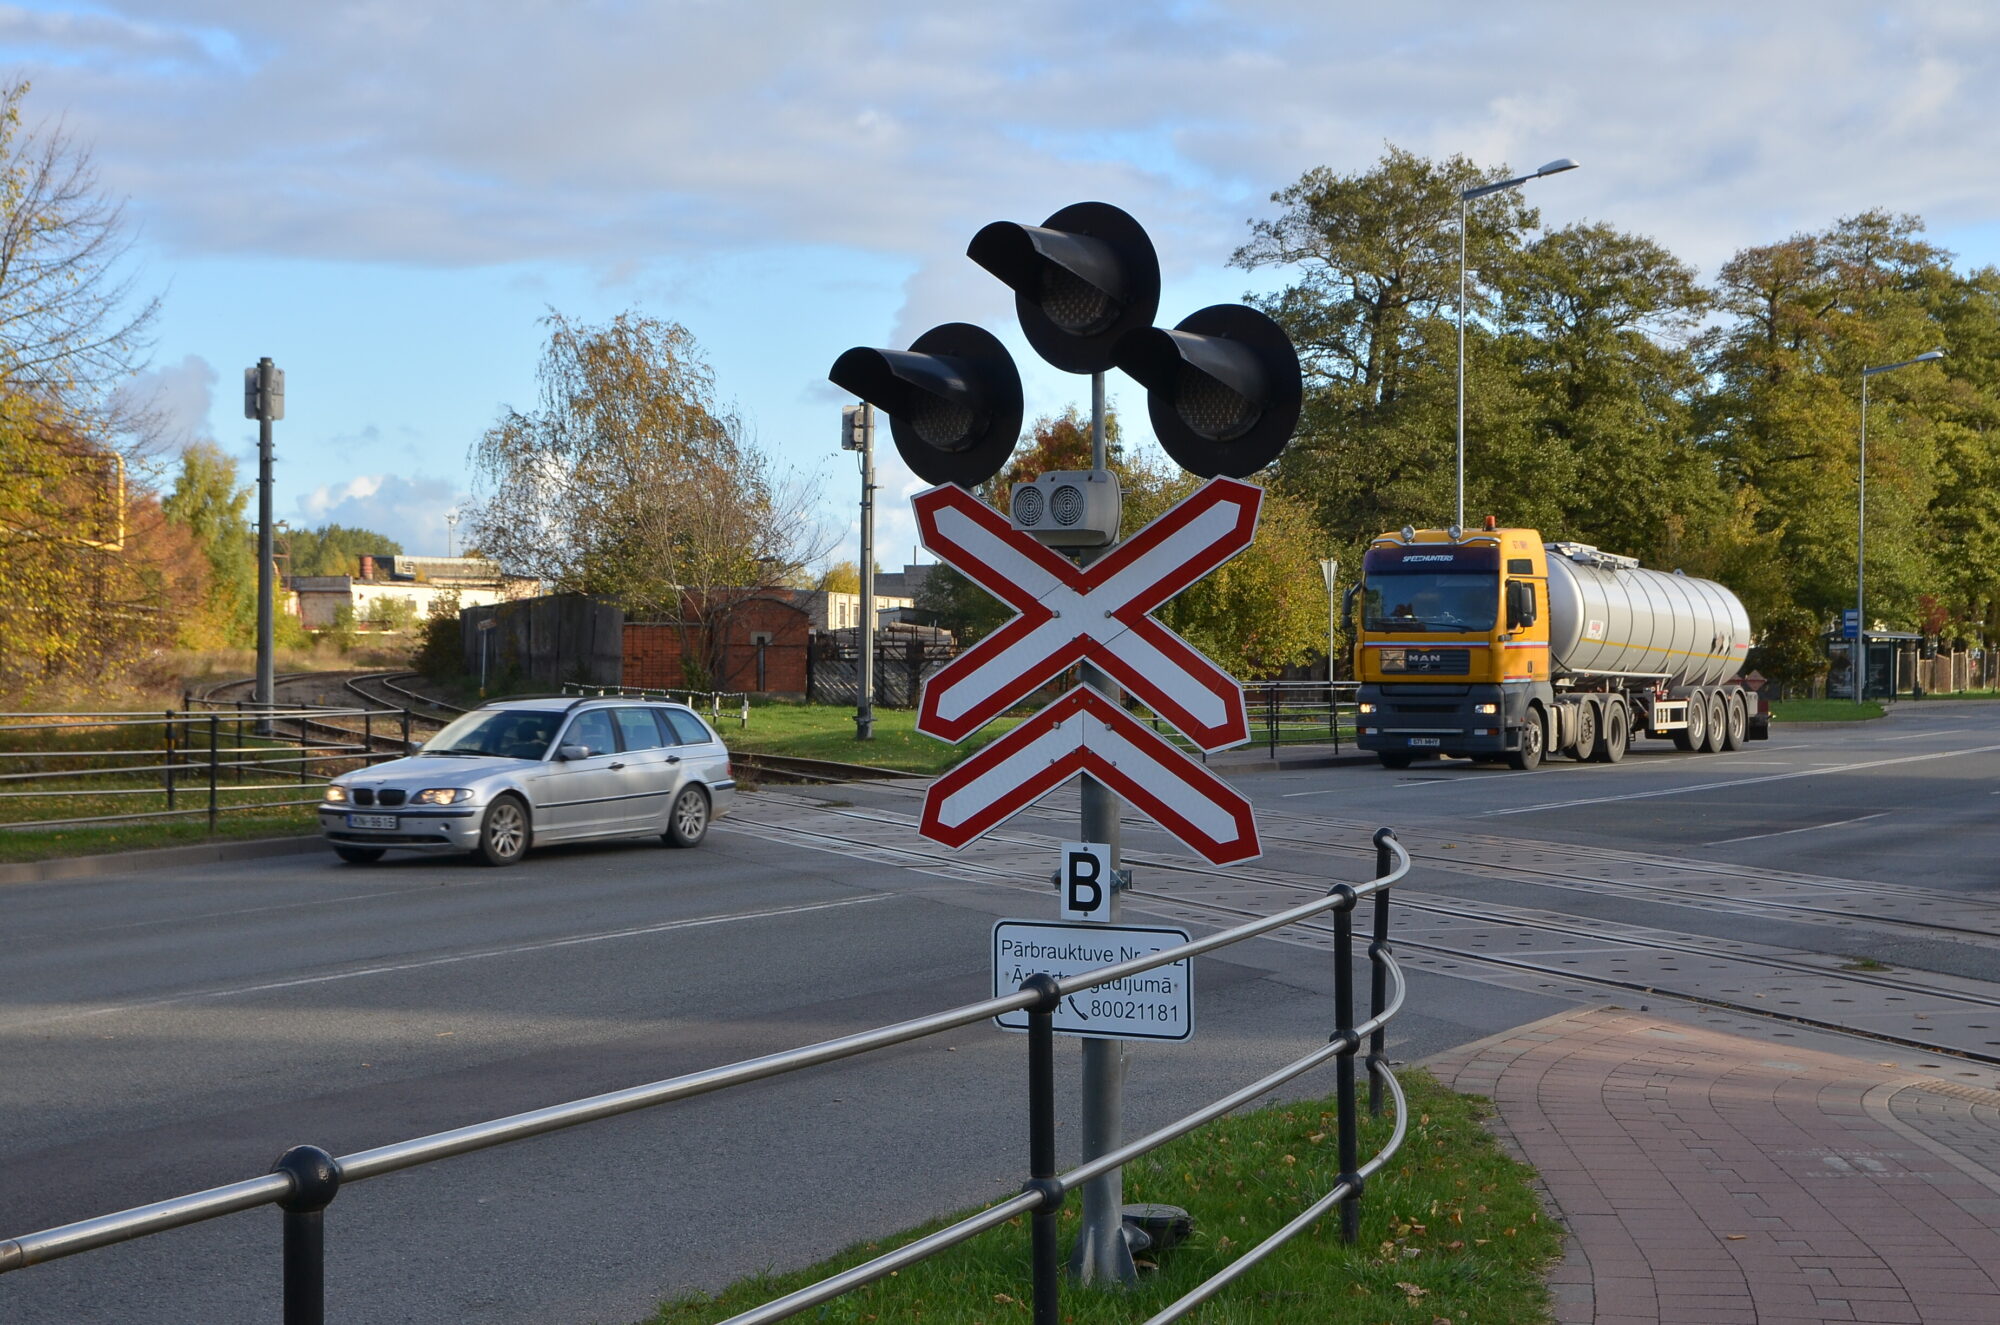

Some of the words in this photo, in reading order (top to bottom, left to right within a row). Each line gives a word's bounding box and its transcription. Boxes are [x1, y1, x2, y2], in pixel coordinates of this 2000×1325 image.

[1408, 654, 1440, 662] MAN
[1068, 852, 1102, 912] B
[1001, 939, 1114, 963] Pārbrauktuve
[1091, 1000, 1178, 1022] 80021181
